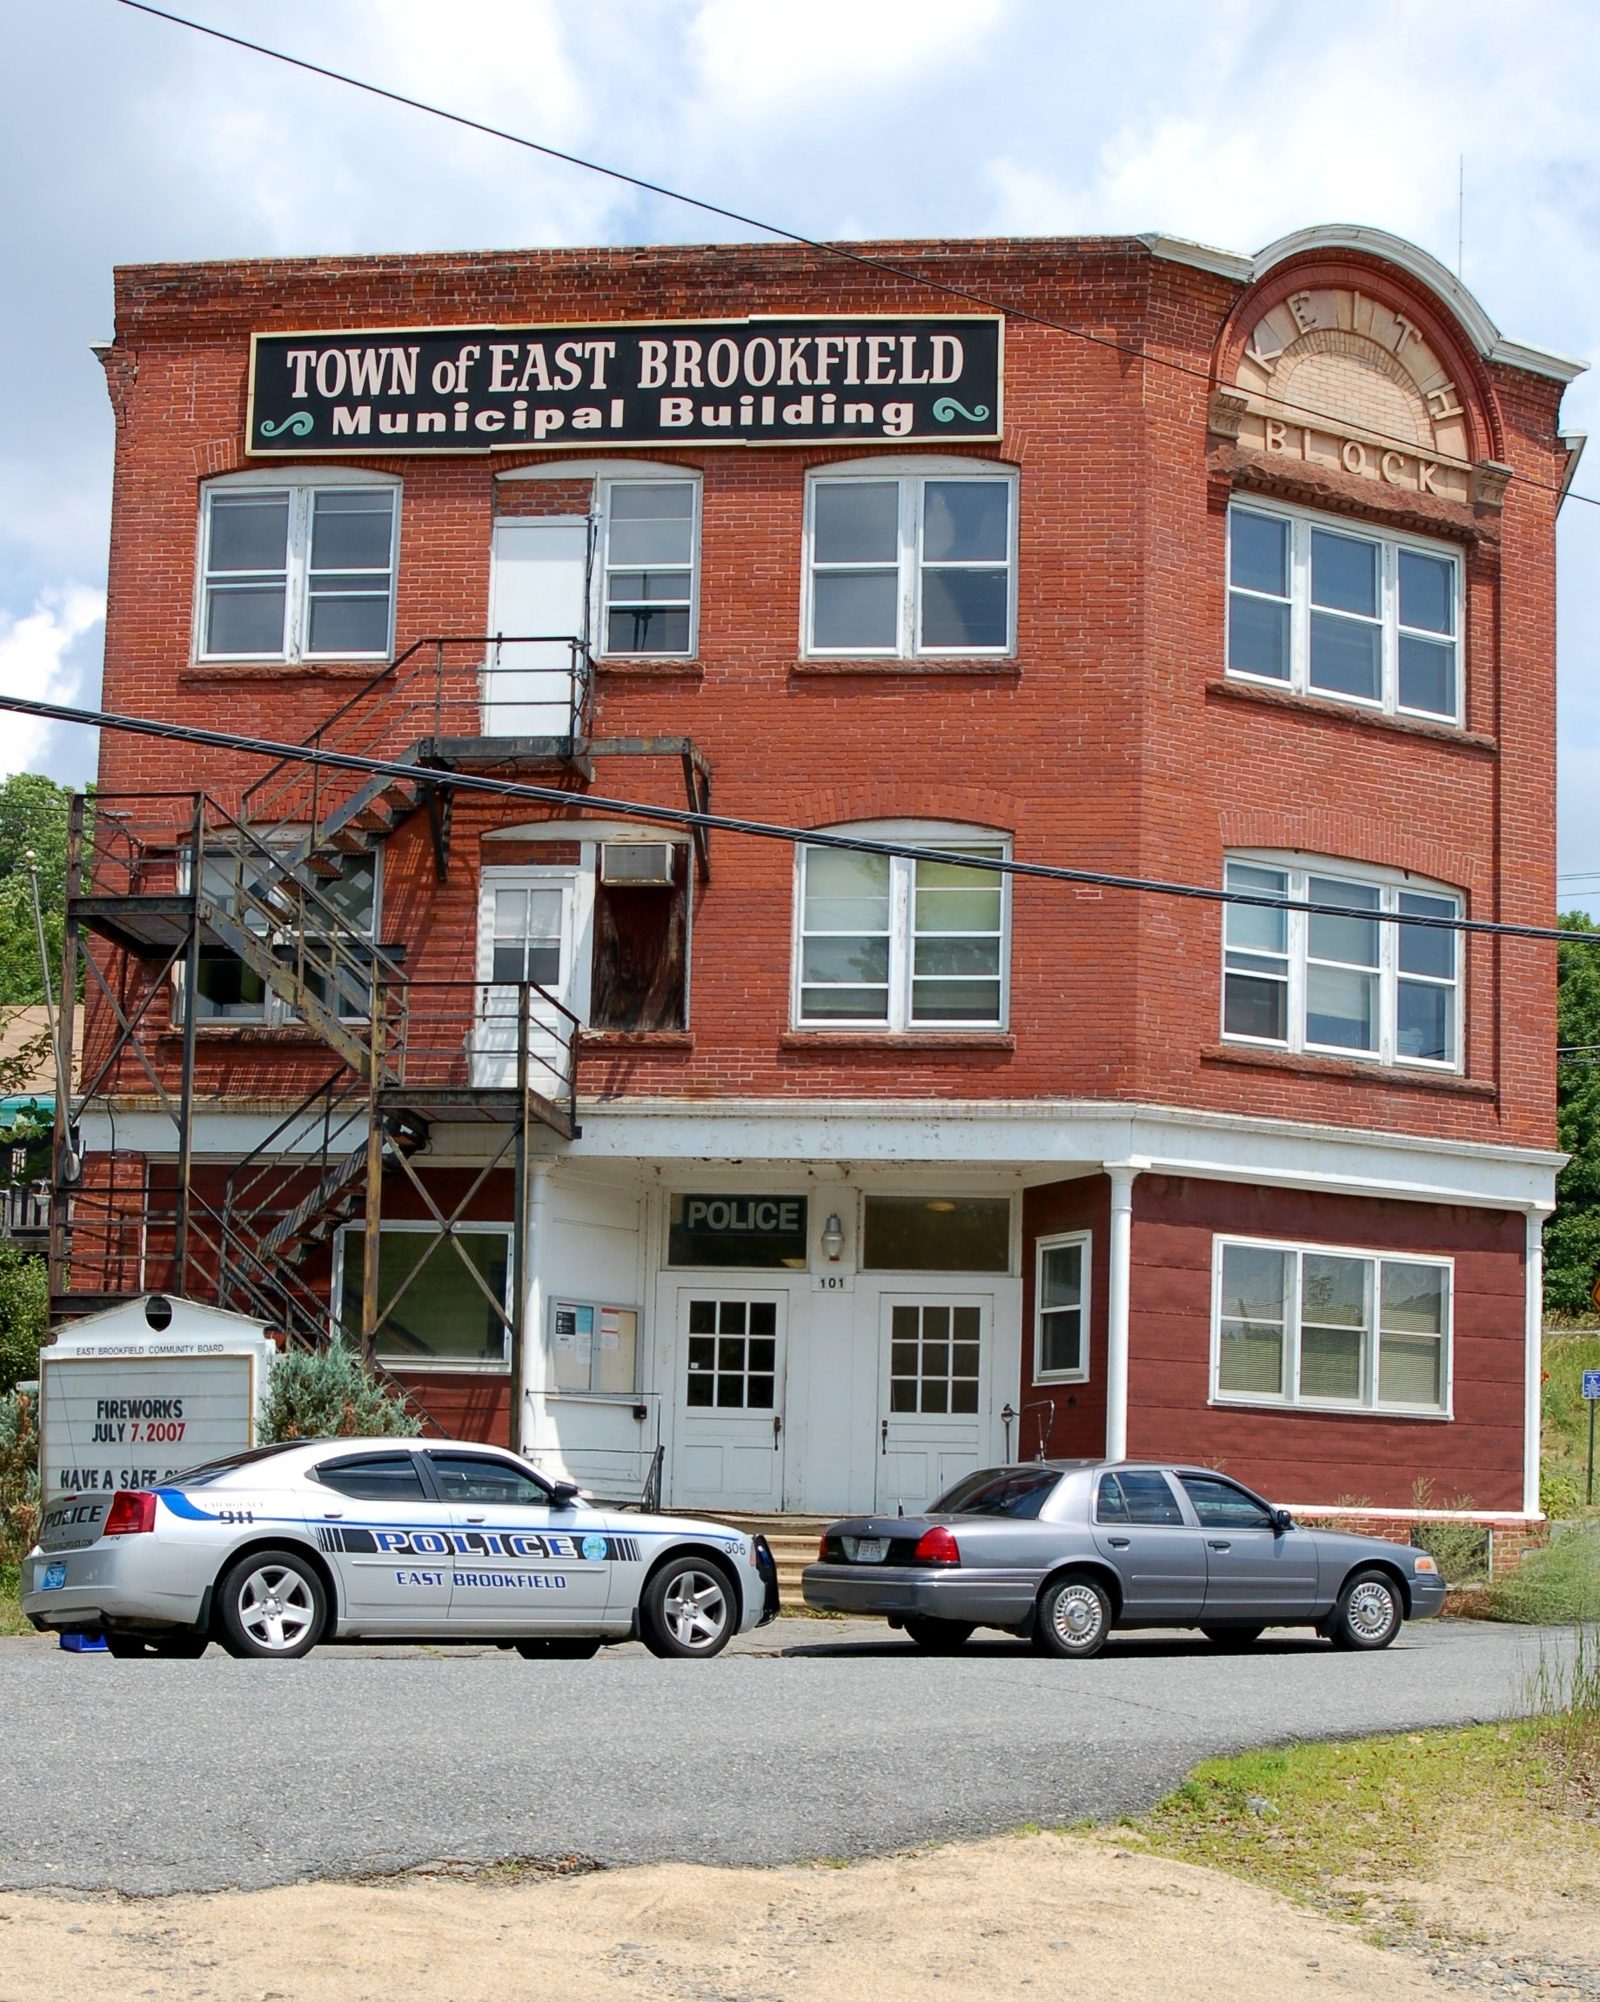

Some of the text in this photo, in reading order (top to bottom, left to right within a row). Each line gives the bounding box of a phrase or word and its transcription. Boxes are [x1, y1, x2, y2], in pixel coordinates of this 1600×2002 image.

[1245, 290, 1465, 420] KEITH
[286, 335, 964, 399] TOWN of EAST BROOKFIELD
[332, 393, 914, 440] Municipal Building
[1264, 418, 1441, 495] BLOCK
[688, 1201, 799, 1231] POLICE
[820, 1277, 845, 1290] 101
[76, 1344, 224, 1356] EAST BROOKFIELD COMMUNITY BOARD
[97, 1399, 183, 1419] FIREWORKS
[91, 1423, 126, 1443] JULY
[60, 1469, 98, 1489] HAVE
[102, 1470, 114, 1489] A
[43, 1505, 104, 1531] POLICE
[219, 1510, 254, 1525] 911
[369, 1530, 579, 1559] POLICE
[725, 1542, 746, 1556] 306
[396, 1571, 567, 1589] EAST BROOKFIELD
